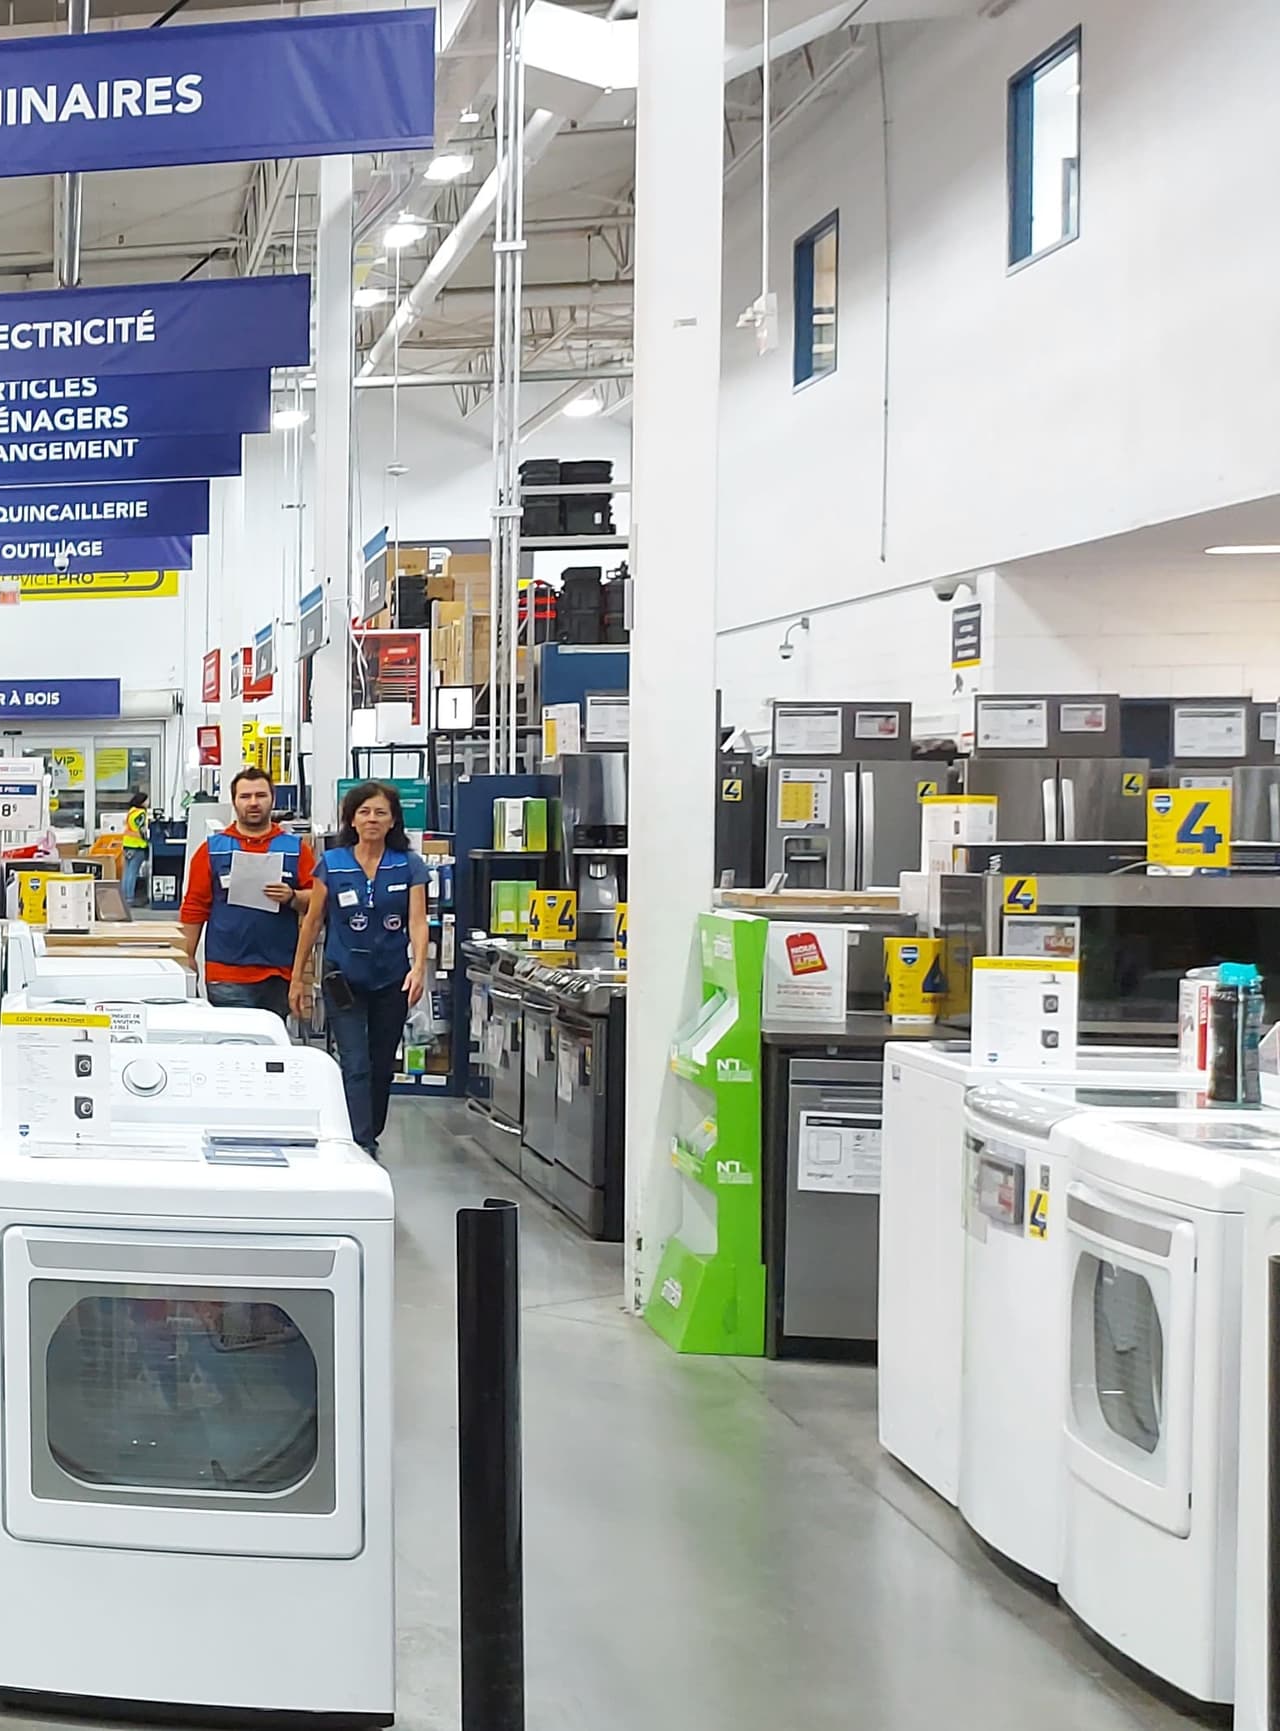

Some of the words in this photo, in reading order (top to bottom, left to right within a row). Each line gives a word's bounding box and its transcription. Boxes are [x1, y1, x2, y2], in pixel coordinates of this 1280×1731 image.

[1, 541, 103, 559] OUTILLAGE
[9, 689, 21, 706] À
[24, 691, 61, 706] BOIS
[1177, 801, 1223, 854] 4
[1008, 879, 1035, 910] 4
[558, 900, 575, 931] 4
